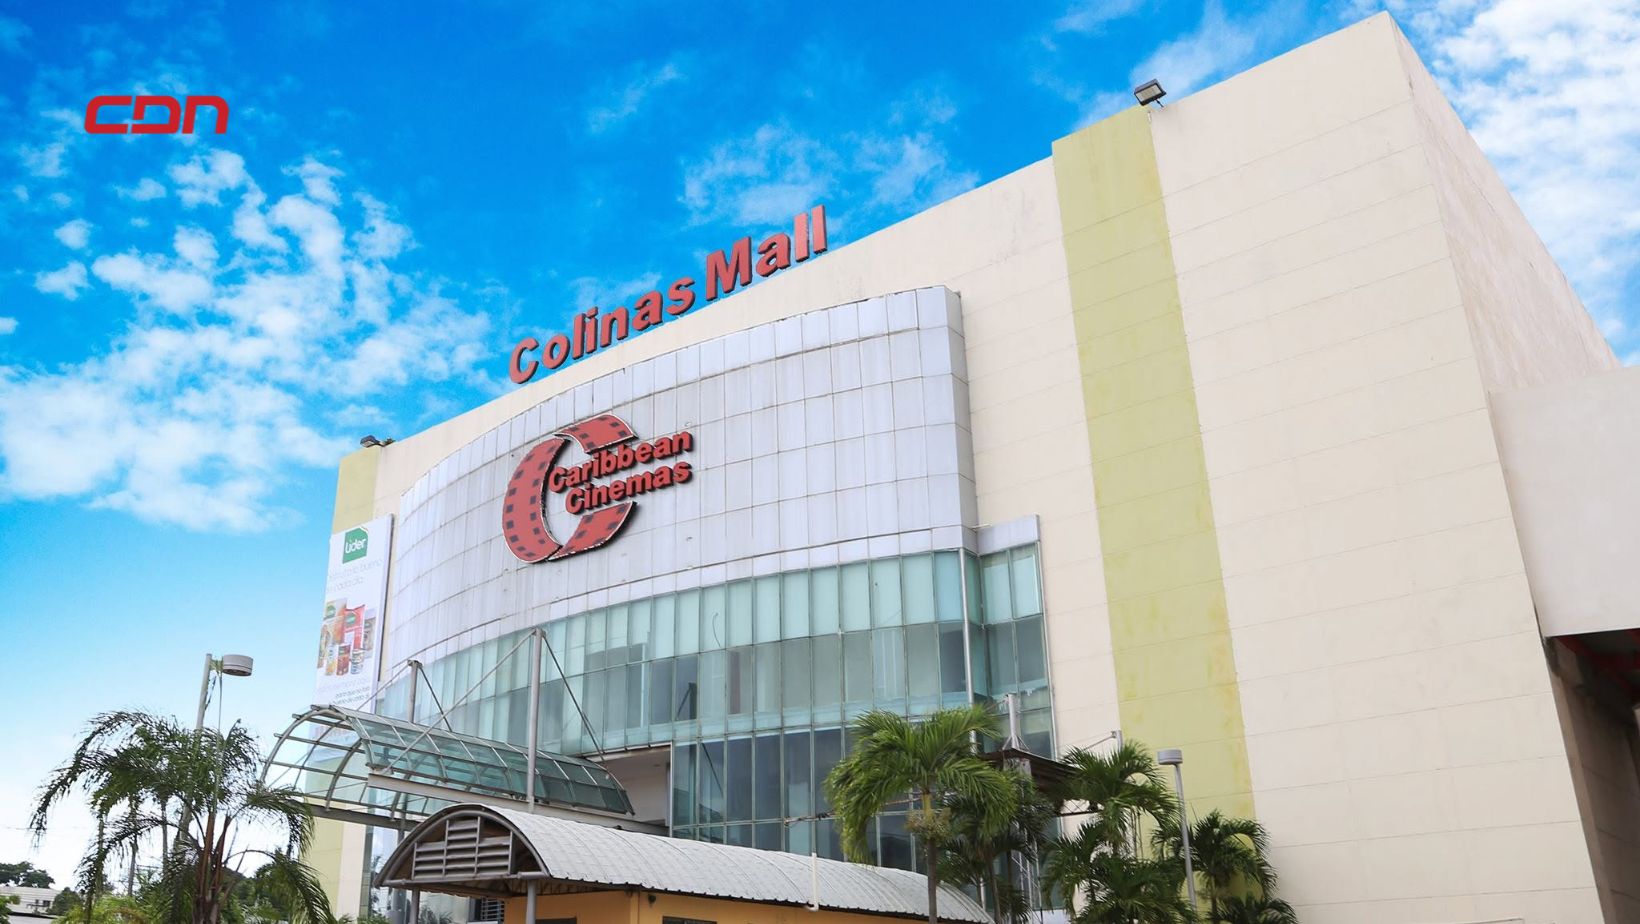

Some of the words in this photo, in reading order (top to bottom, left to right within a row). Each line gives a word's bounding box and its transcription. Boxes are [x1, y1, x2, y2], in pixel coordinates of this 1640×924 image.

[508, 276, 695, 384] Colinas
[705, 204, 828, 301] Mall
[548, 431, 694, 493] Caribbean
[565, 461, 693, 514] Cinemas
